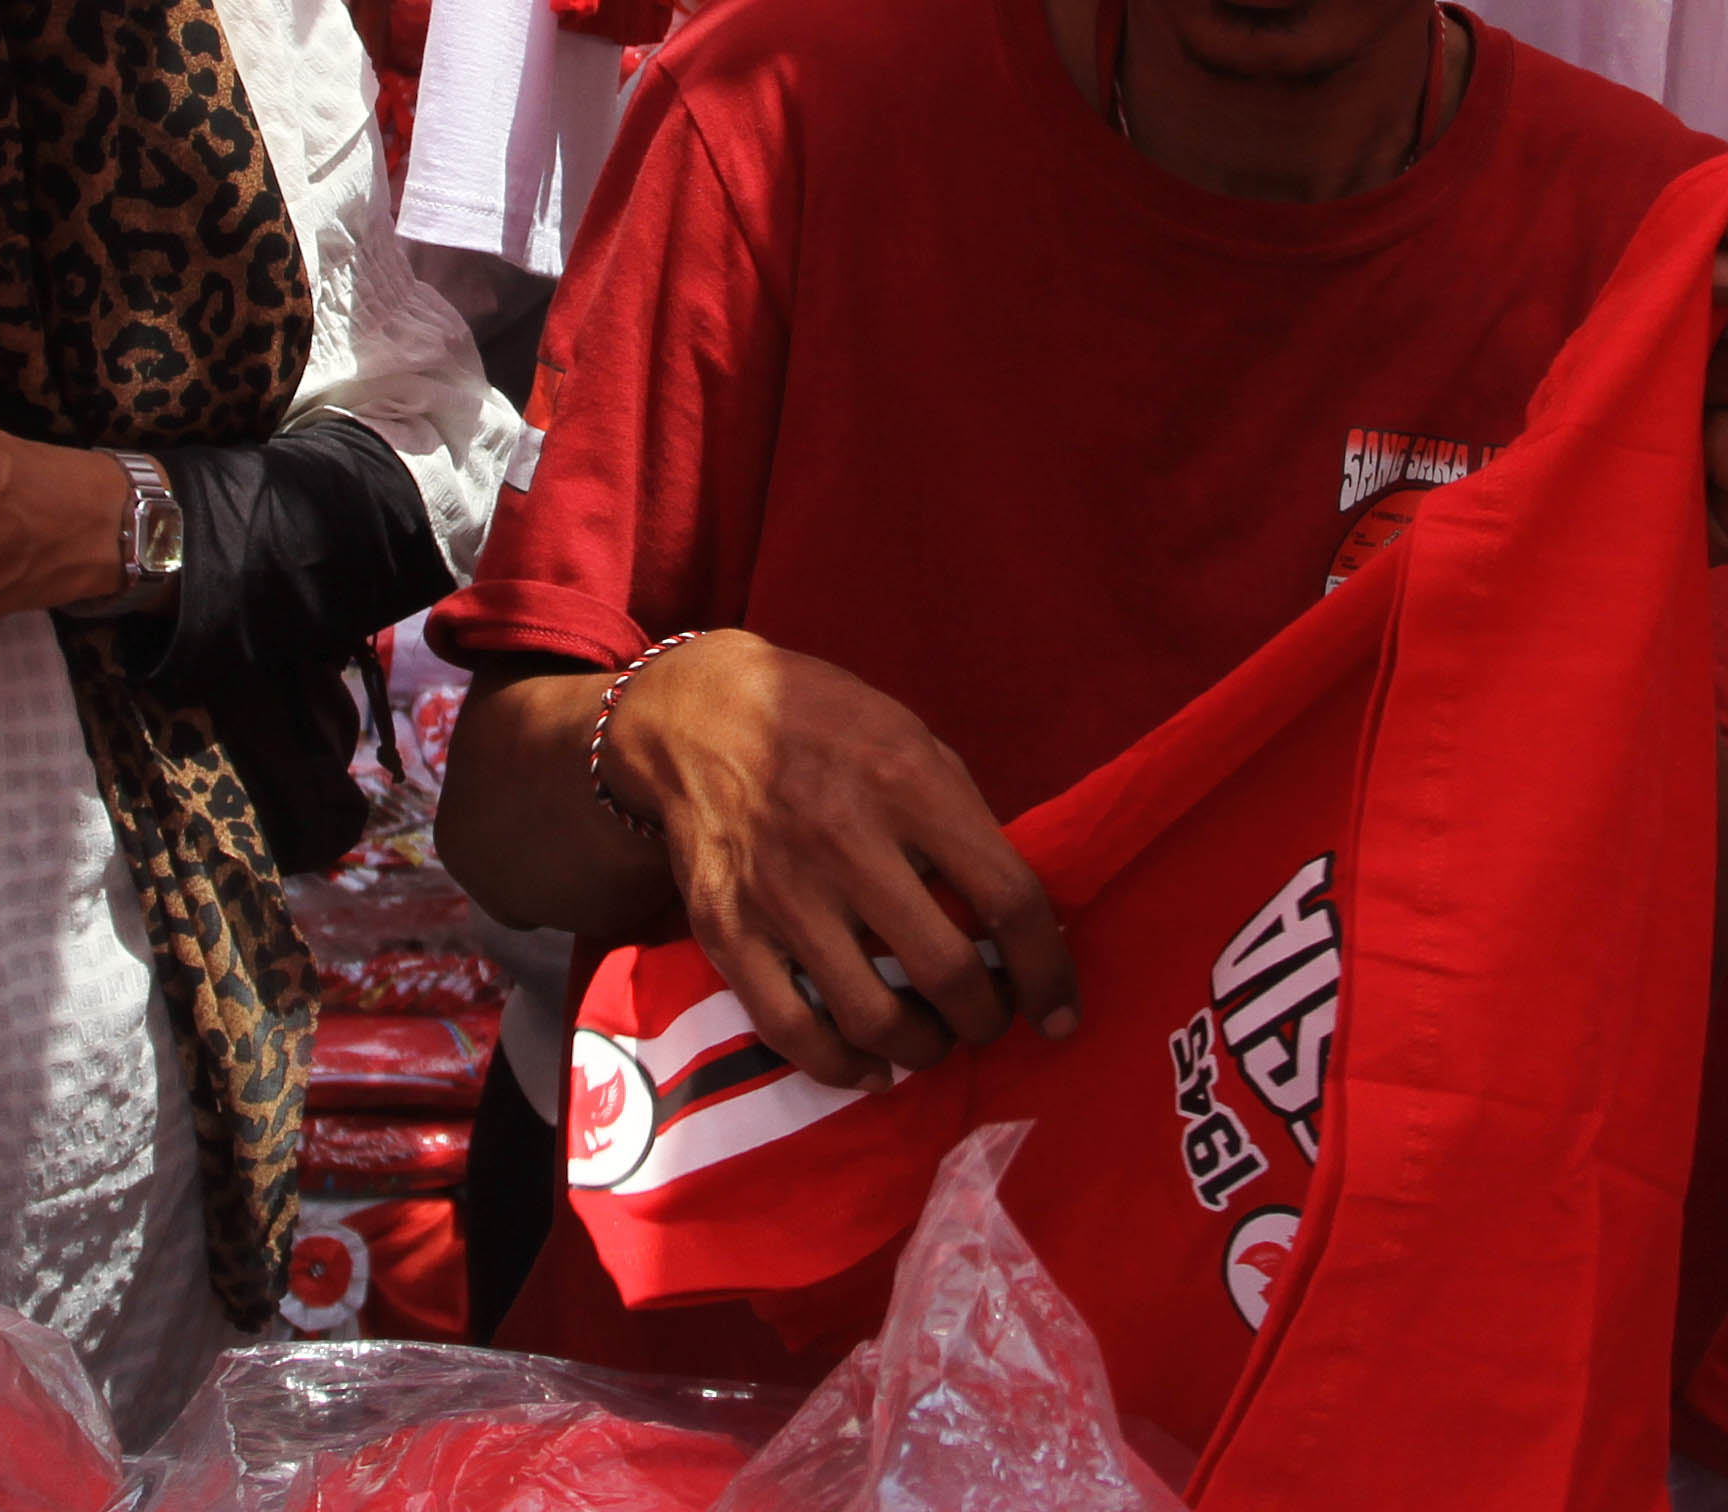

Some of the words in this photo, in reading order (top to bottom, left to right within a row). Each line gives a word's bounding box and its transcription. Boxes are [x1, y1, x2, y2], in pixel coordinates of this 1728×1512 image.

[1339, 427, 1411, 512] SANG
[1405, 437, 1469, 485] SAKA
[1168, 1007, 1269, 1211] 1945
[1209, 851, 1342, 1166] SIA
